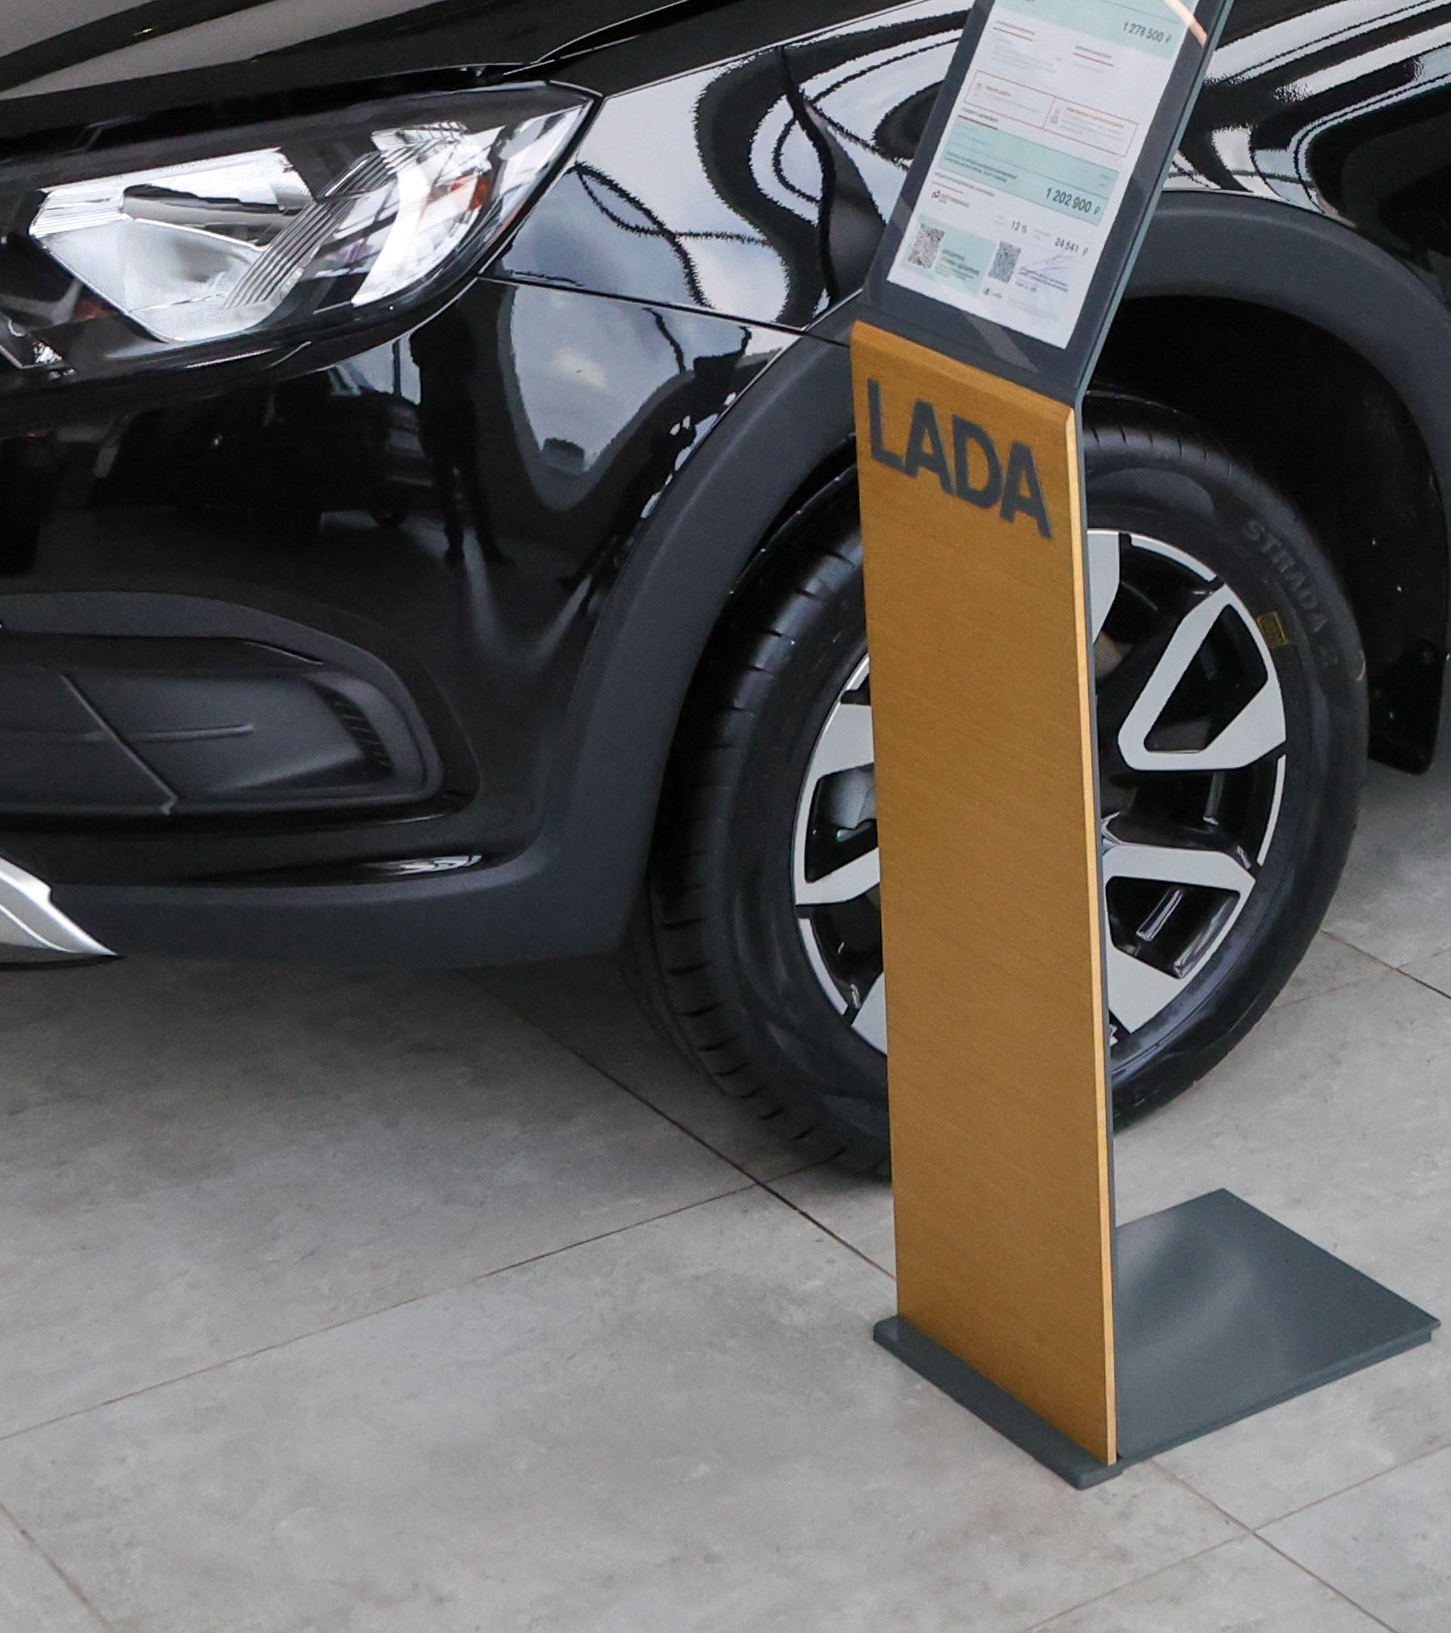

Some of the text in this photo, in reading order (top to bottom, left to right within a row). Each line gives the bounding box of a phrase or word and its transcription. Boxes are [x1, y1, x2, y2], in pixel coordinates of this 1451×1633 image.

[1054, 189, 1071, 206] 202
[1071, 196, 1093, 213] 900
[866, 377, 1053, 539] LADA
